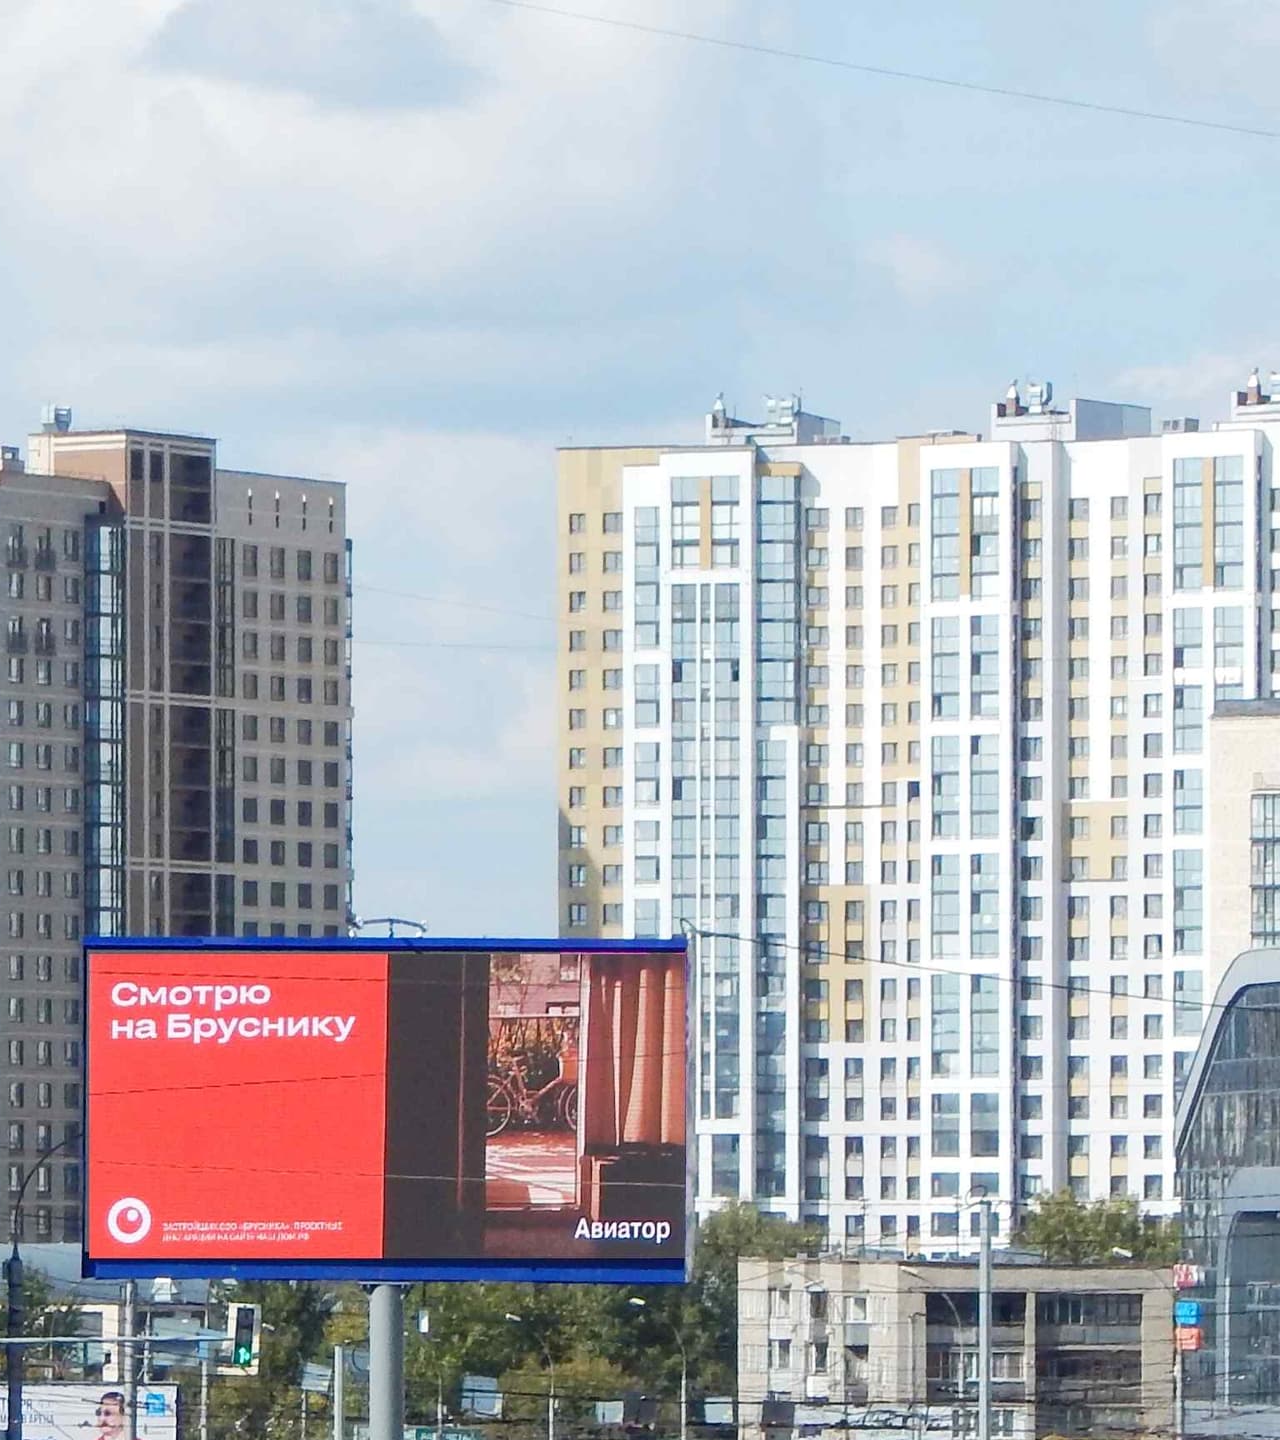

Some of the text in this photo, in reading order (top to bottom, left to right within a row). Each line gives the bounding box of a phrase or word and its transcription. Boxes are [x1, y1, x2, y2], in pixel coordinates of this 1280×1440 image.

[111, 982, 271, 1011] Смотрю
[111, 1013, 356, 1044] на Бруснику
[574, 1217, 671, 1244] Авиатор
